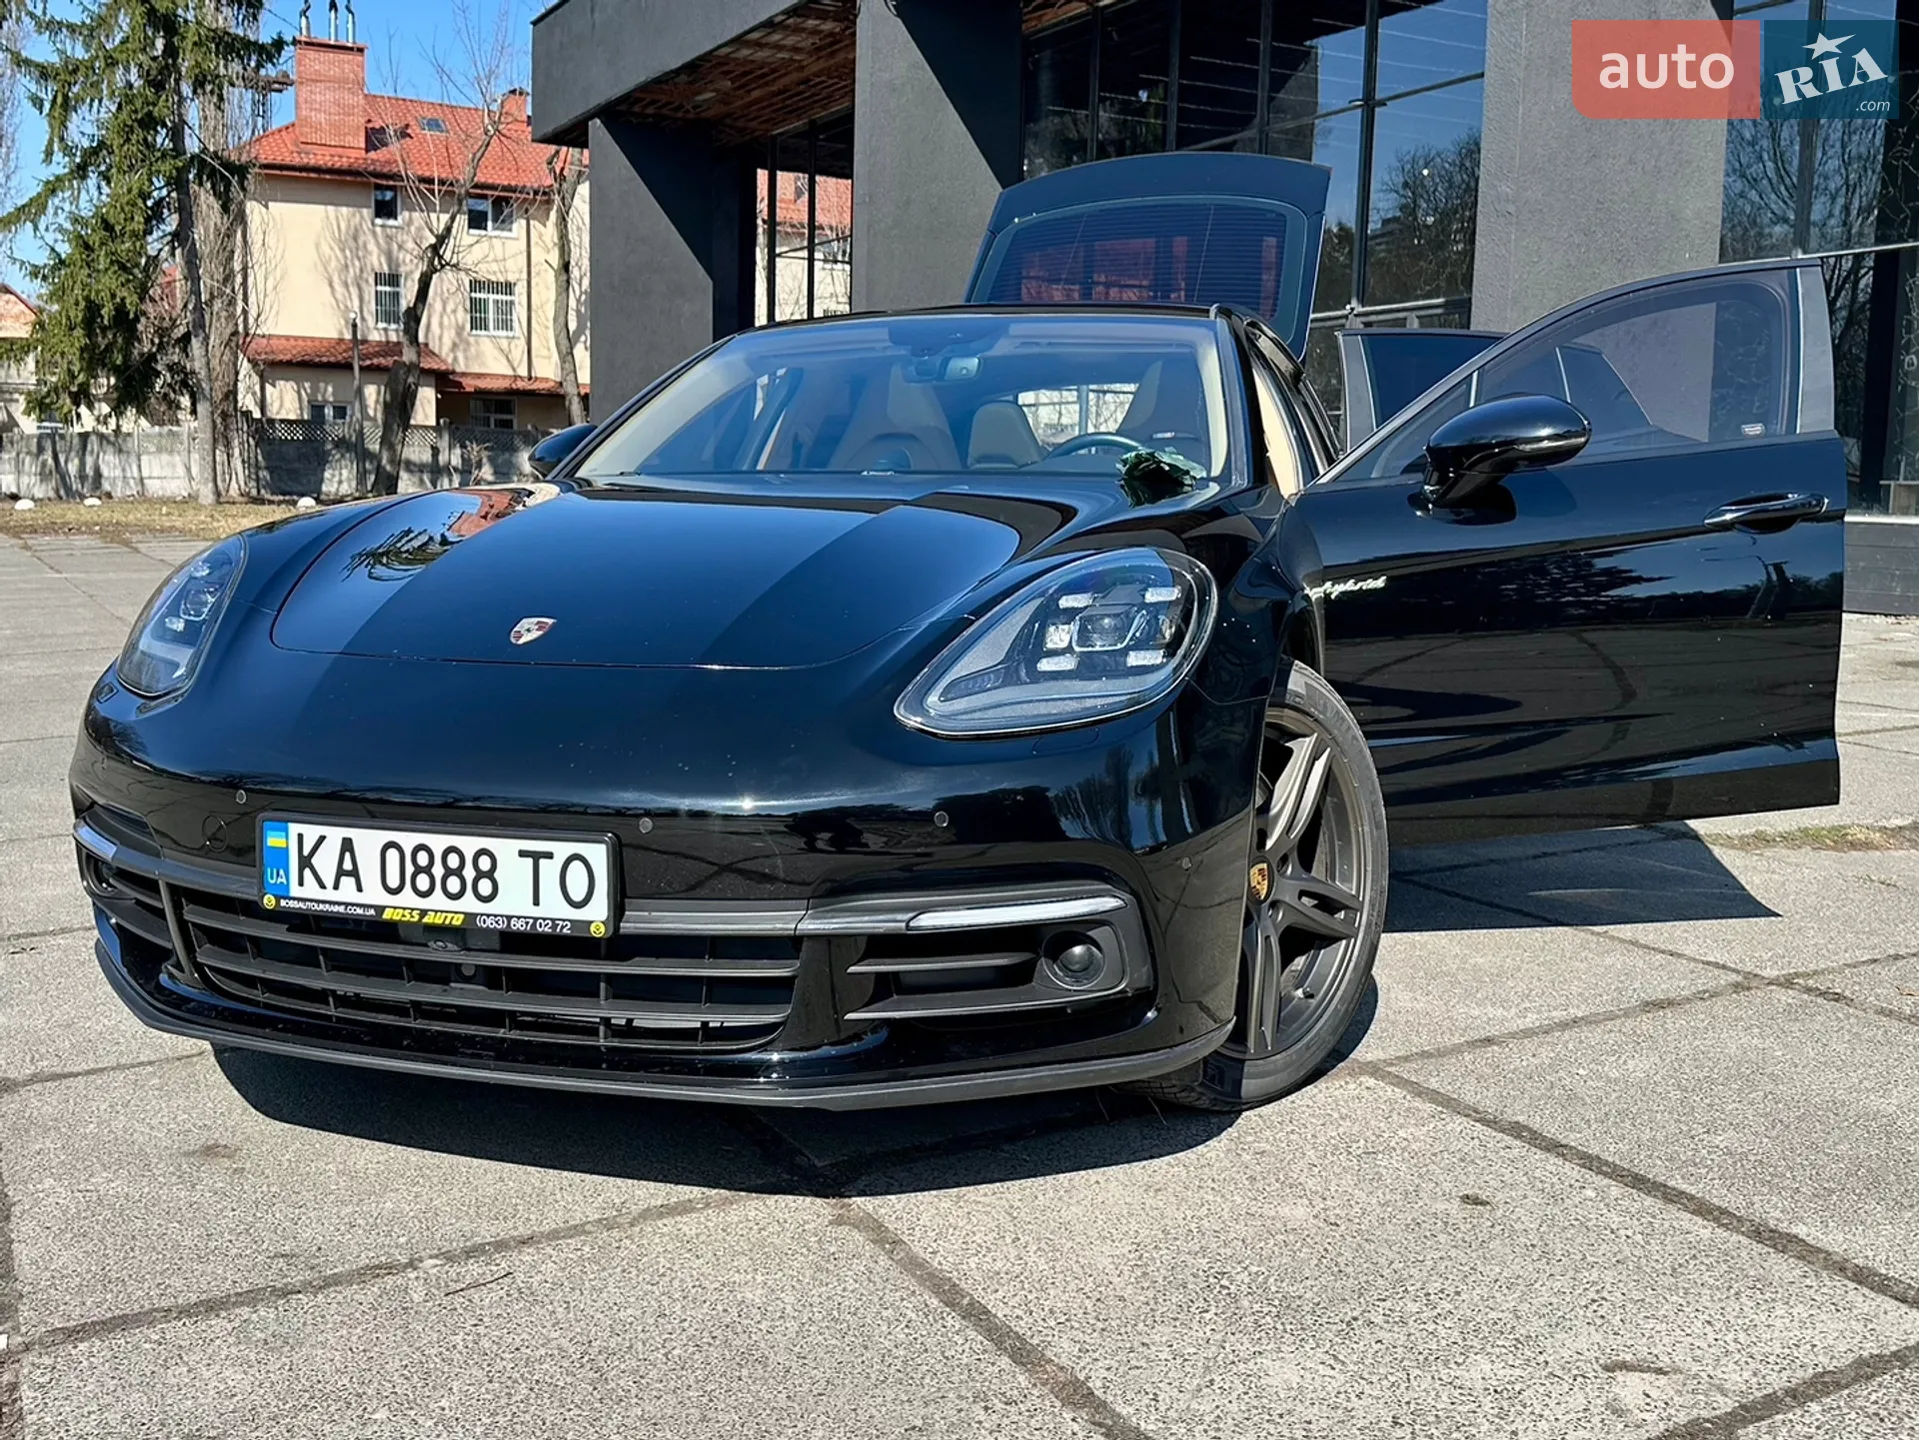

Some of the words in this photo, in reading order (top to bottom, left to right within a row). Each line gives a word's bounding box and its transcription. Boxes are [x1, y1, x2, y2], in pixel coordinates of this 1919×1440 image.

[267, 868, 287, 885] UA
[296, 832, 364, 893] KA
[379, 840, 500, 904] 0888
[517, 849, 596, 910] TO
[381, 907, 421, 923] BOSS
[422, 911, 466, 926] AUTO
[475, 915, 508, 930] (063)
[510, 917, 532, 931] 667
[535, 919, 552, 933] 02
[555, 920, 572, 934] 72
